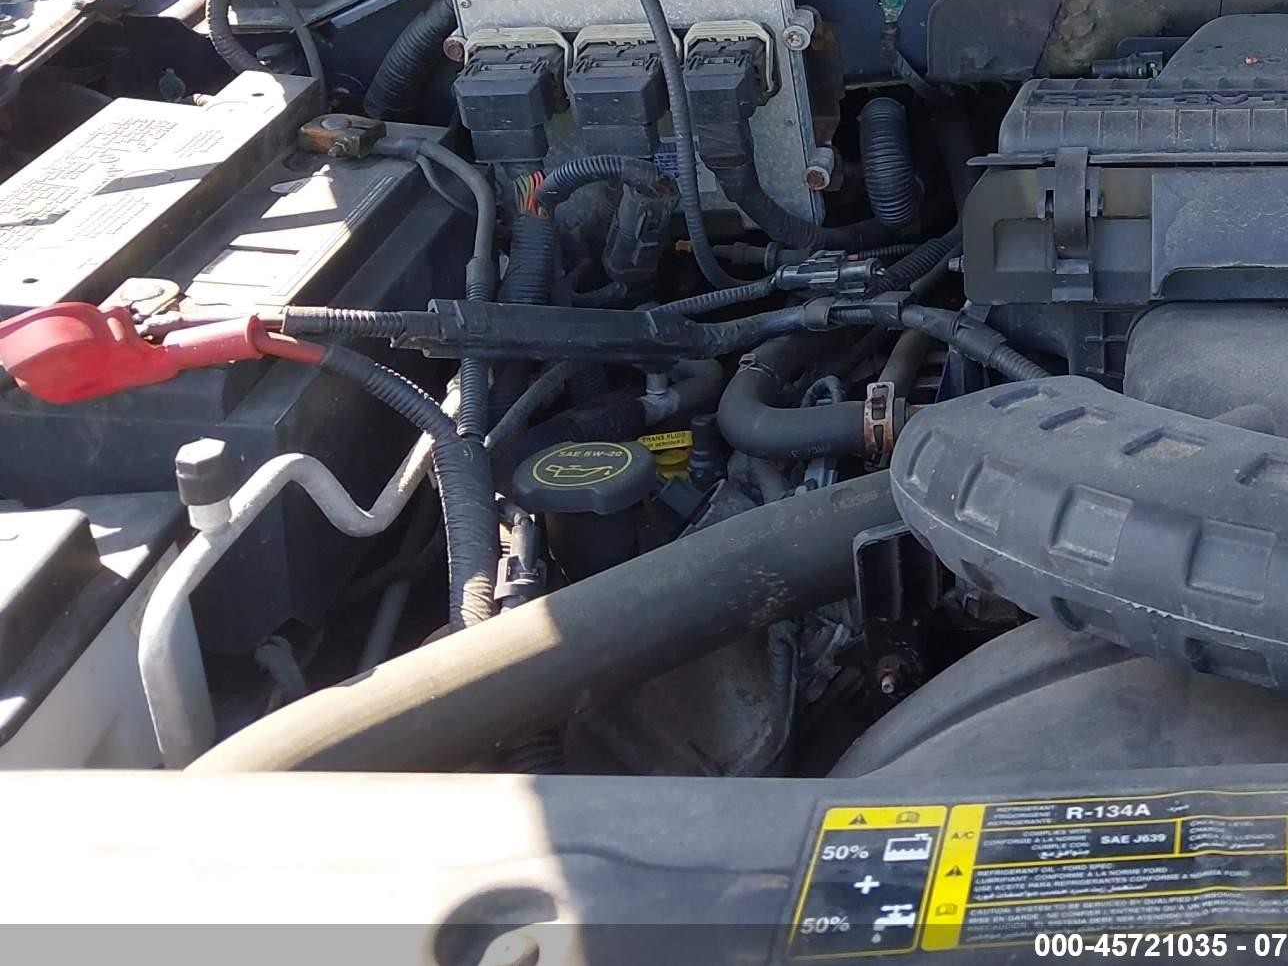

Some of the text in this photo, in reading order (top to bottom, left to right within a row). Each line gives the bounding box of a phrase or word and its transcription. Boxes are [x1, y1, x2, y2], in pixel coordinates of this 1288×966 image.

[558, 450, 623, 458] SAE 5W-20
[1065, 803, 1152, 820] R-134A
[951, 831, 975, 839] A/C
[1101, 833, 1167, 845] SAE J639
[821, 845, 869, 861] 50%
[801, 916, 850, 934] 50%
